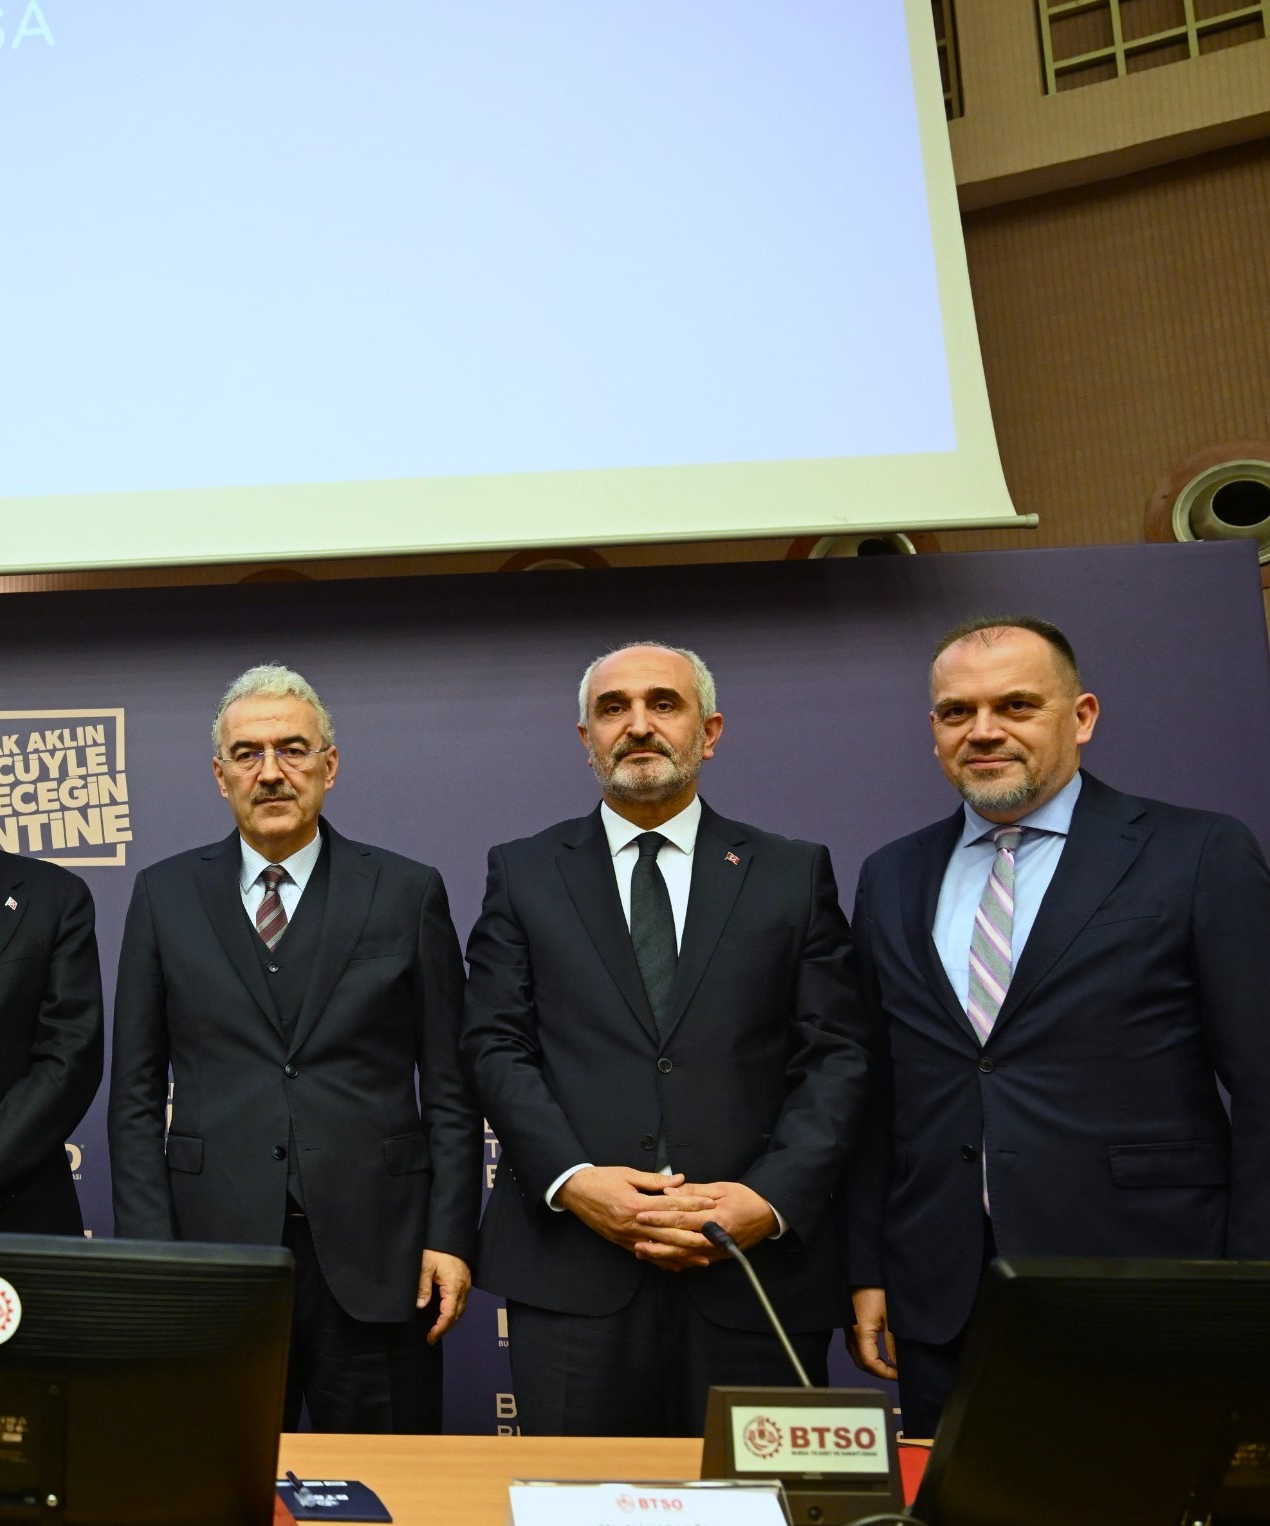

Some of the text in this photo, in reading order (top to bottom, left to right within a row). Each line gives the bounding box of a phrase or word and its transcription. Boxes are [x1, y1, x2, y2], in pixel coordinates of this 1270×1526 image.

[26, 724, 106, 752] AKLIN
[790, 1426, 877, 1449] BTSO
[638, 1497, 683, 1511] BTSO
